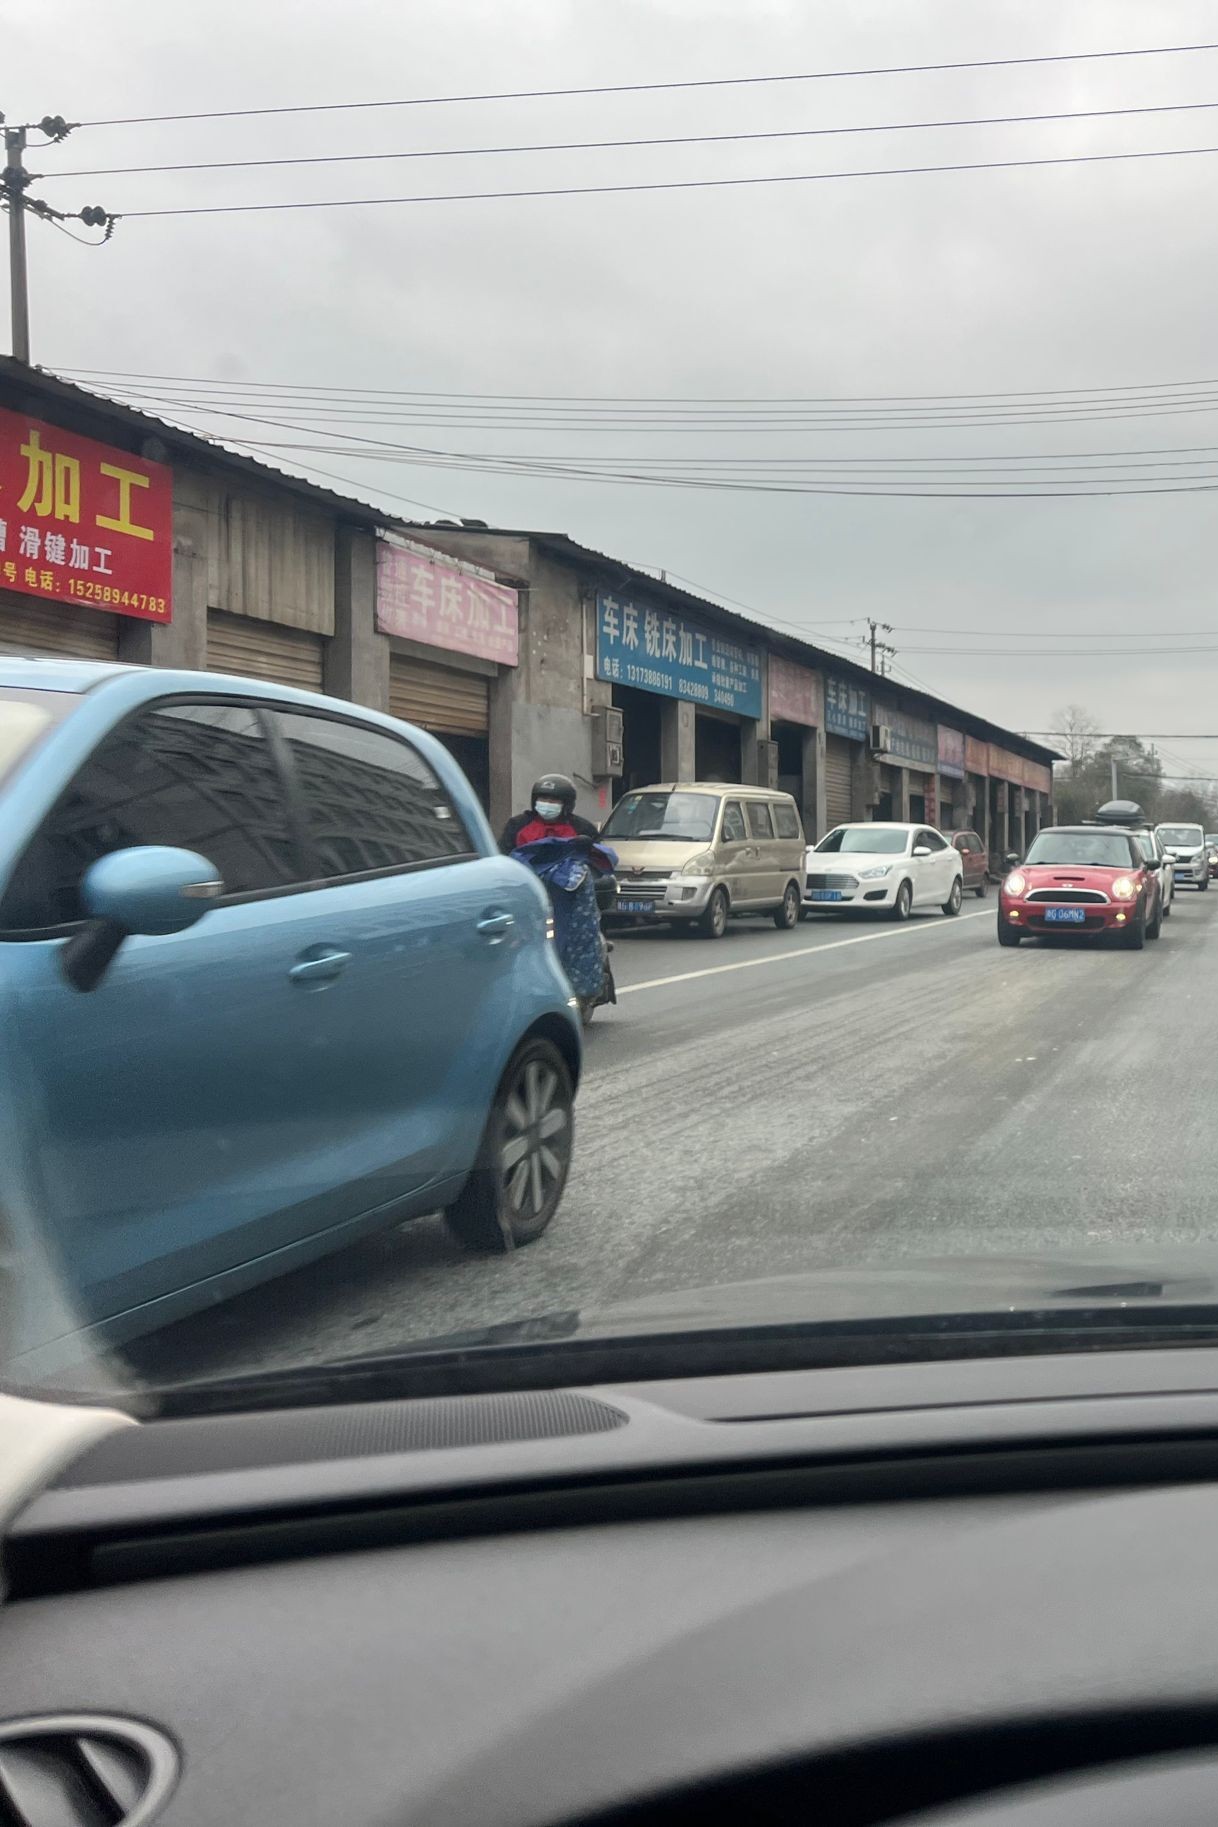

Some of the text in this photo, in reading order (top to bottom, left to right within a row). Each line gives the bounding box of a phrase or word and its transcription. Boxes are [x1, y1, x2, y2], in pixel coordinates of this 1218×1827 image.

[17, 429, 154, 541] 加工
[19, 525, 112, 575] 滑键加工
[68, 578, 166, 613] 15258944783
